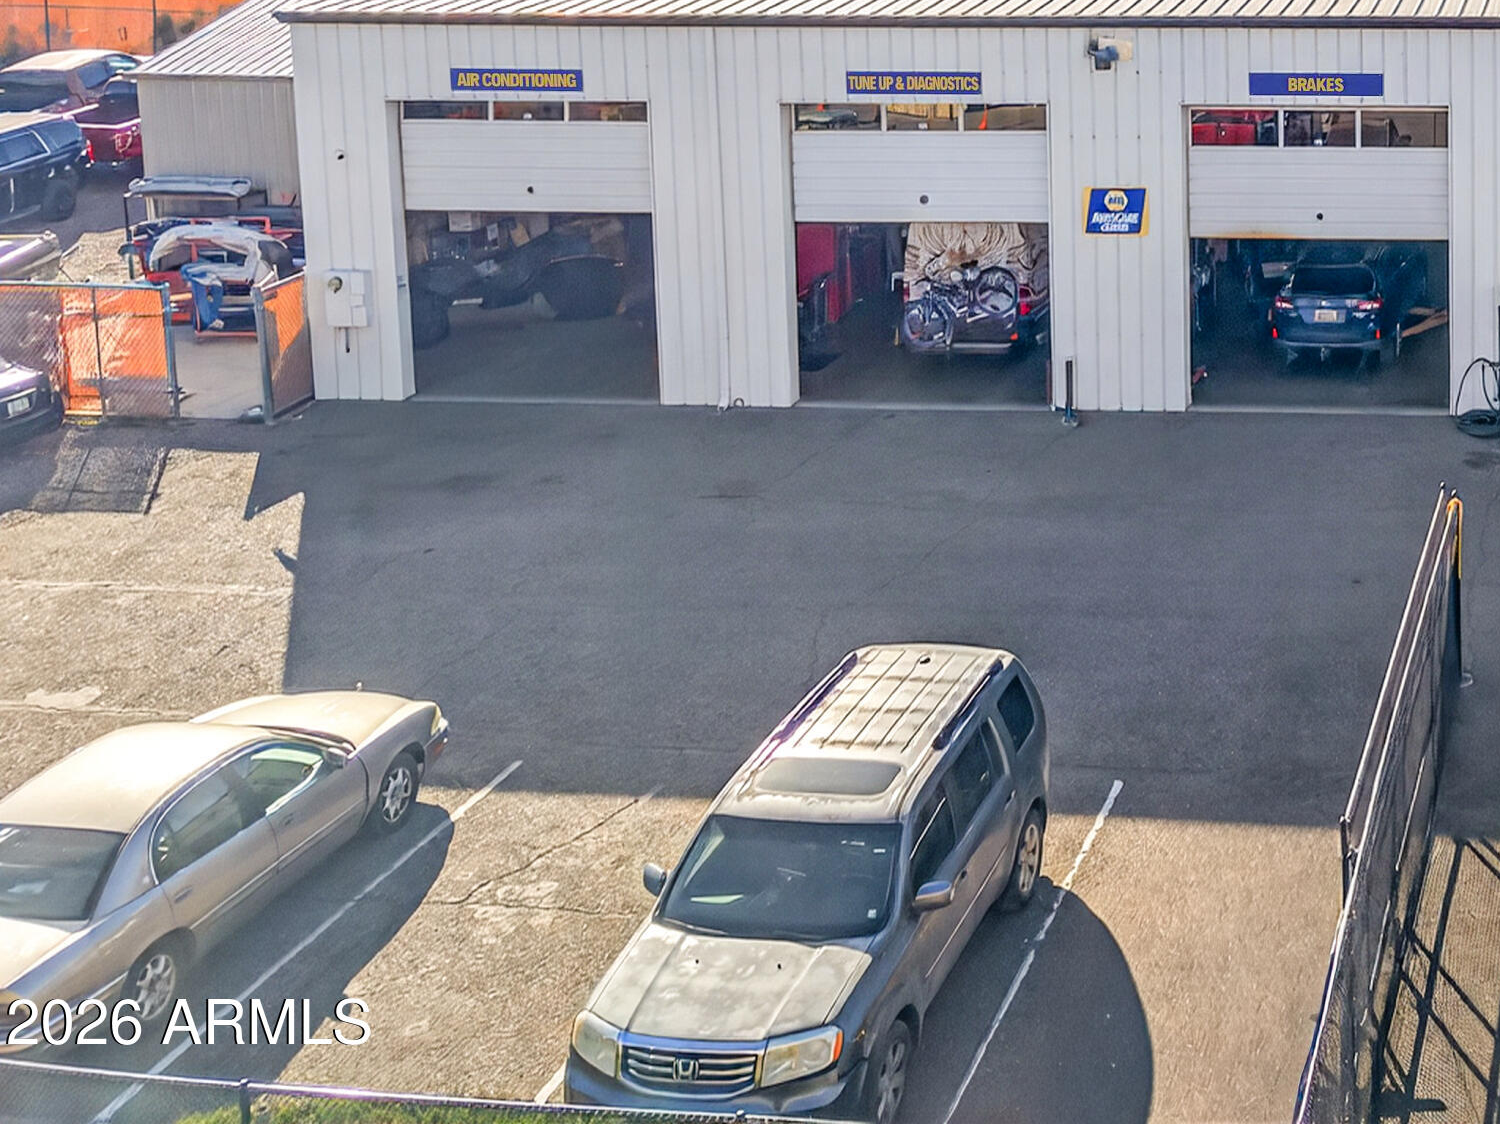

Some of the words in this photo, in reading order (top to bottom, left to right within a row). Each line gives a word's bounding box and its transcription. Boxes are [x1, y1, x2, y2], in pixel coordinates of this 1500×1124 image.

[457, 72, 479, 87] AIR
[481, 72, 577, 88] CONDITIONING
[848, 75, 877, 90] TUNE
[879, 76, 894, 90] UP
[895, 76, 904, 90] &
[906, 76, 979, 91] DIAGNOSTICS
[1287, 77, 1345, 92] BRAKES
